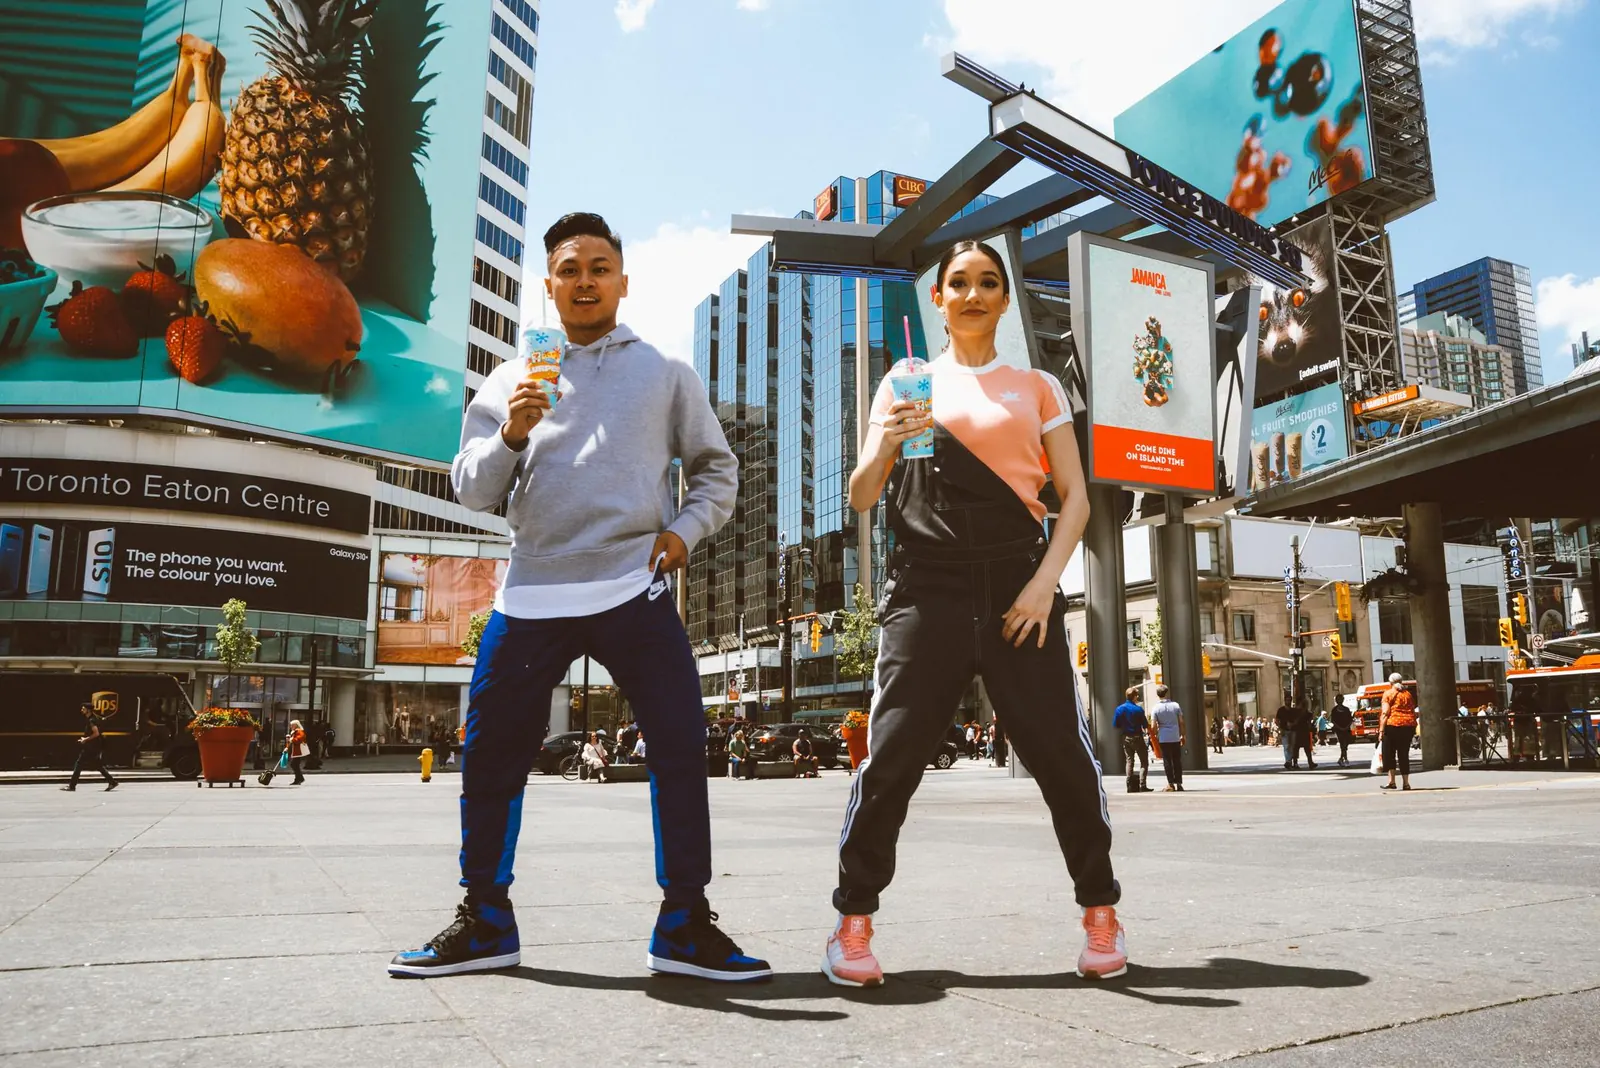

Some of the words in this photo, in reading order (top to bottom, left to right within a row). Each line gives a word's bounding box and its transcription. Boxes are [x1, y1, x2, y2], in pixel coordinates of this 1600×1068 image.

[898, 179, 925, 194] CIBC
[1130, 267, 1167, 290] JAMAICA
[1388, 390, 1407, 403] CITIES
[1262, 418, 1286, 434] FRUIT
[1289, 402, 1338, 426] SMOOTHIES
[1126, 452, 1138, 460] ON
[1139, 454, 1166, 464] ISLAND
[1168, 457, 1184, 467] TIME
[1135, 444, 1157, 454] COME
[1158, 447, 1176, 456] DINE
[10, 468, 132, 497] Toronto
[143, 474, 229, 504] Eaton
[241, 484, 330, 518] Centre
[126, 548, 156, 562] The
[159, 551, 212, 567] phone
[215, 556, 243, 570] you
[247, 559, 288, 573] want.
[329, 548, 356, 560] Galaxy
[1508, 526, 1522, 578] Yonge
[91, 540, 113, 584] S10
[125, 565, 155, 578] The
[158, 567, 210, 582] colour
[214, 571, 241, 586] you
[245, 572, 278, 588] love.
[650, 580, 665, 594] NIKE
[93, 699, 117, 715] ups
